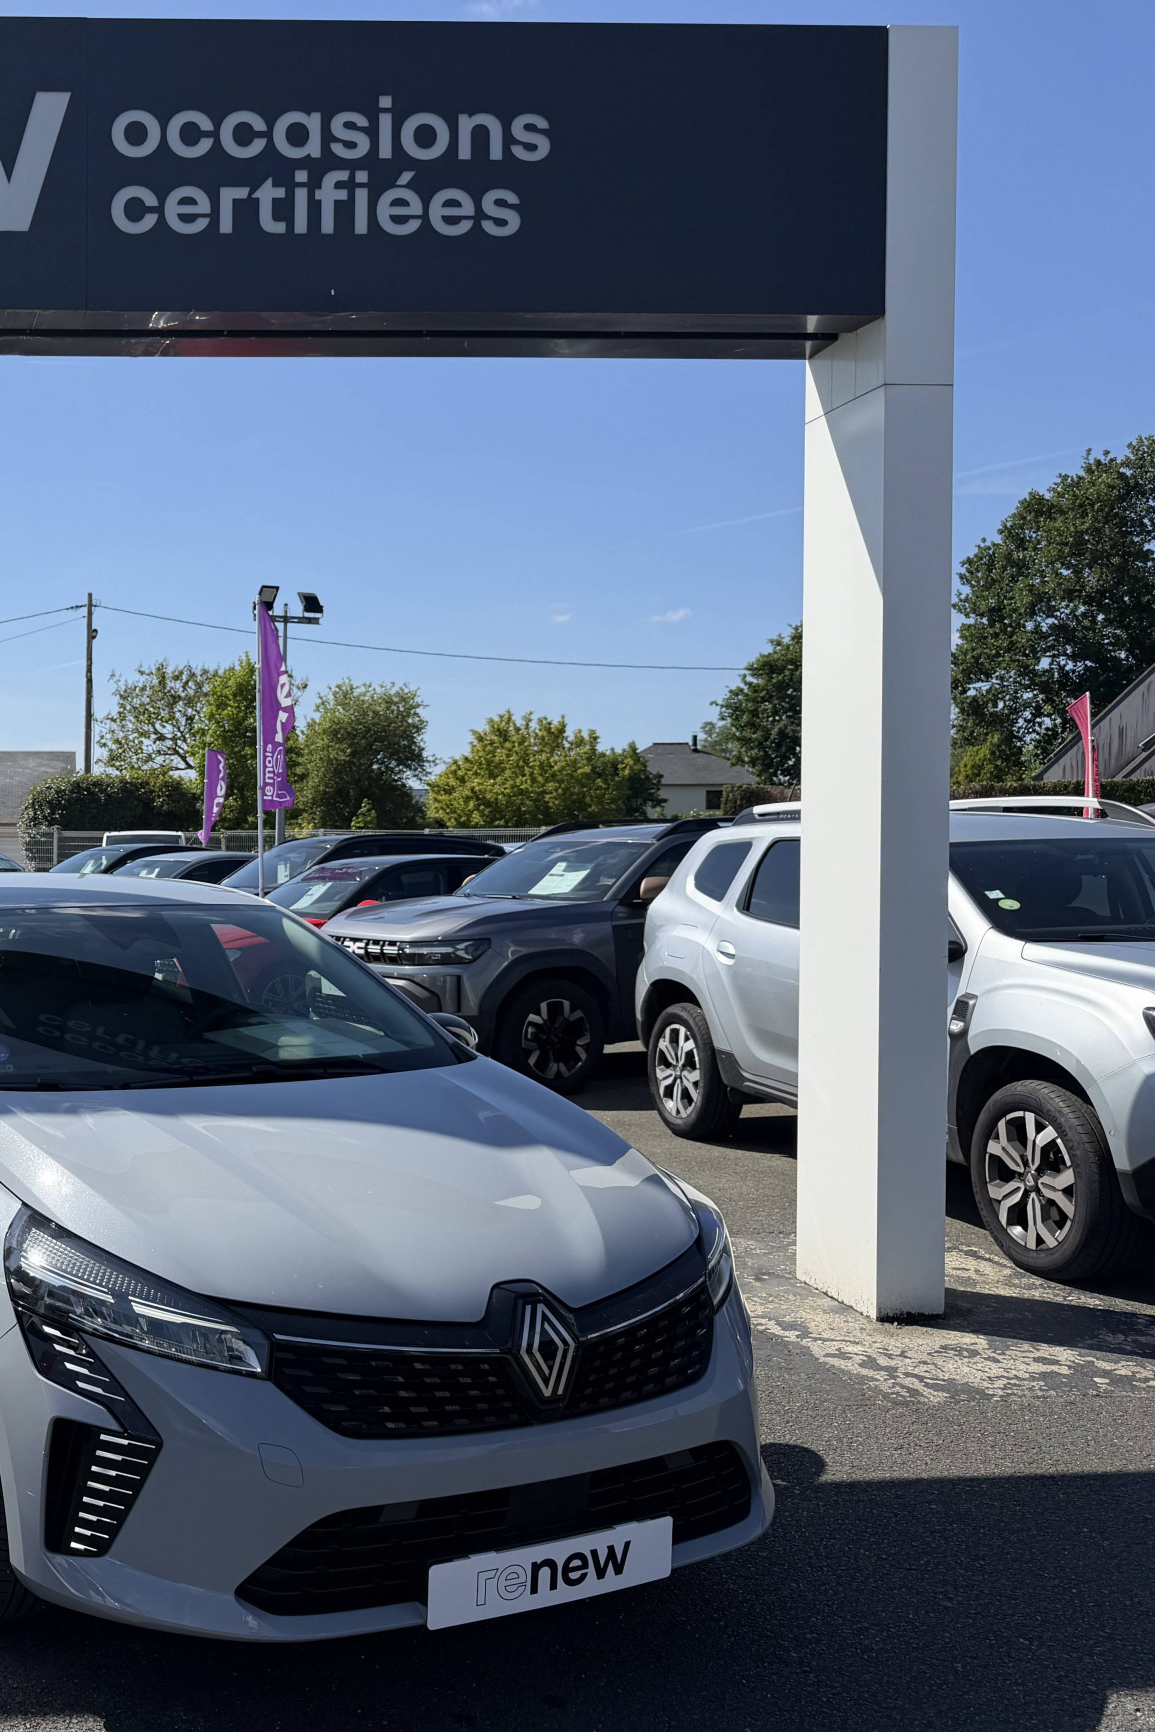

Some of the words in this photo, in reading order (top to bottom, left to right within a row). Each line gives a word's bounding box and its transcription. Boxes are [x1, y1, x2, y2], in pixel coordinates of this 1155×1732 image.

[112, 97, 551, 161] occasions
[112, 172, 522, 235] certifiées
[264, 743, 274, 783] mois
[264, 786, 273, 800] le
[476, 1539, 632, 1607] renew
